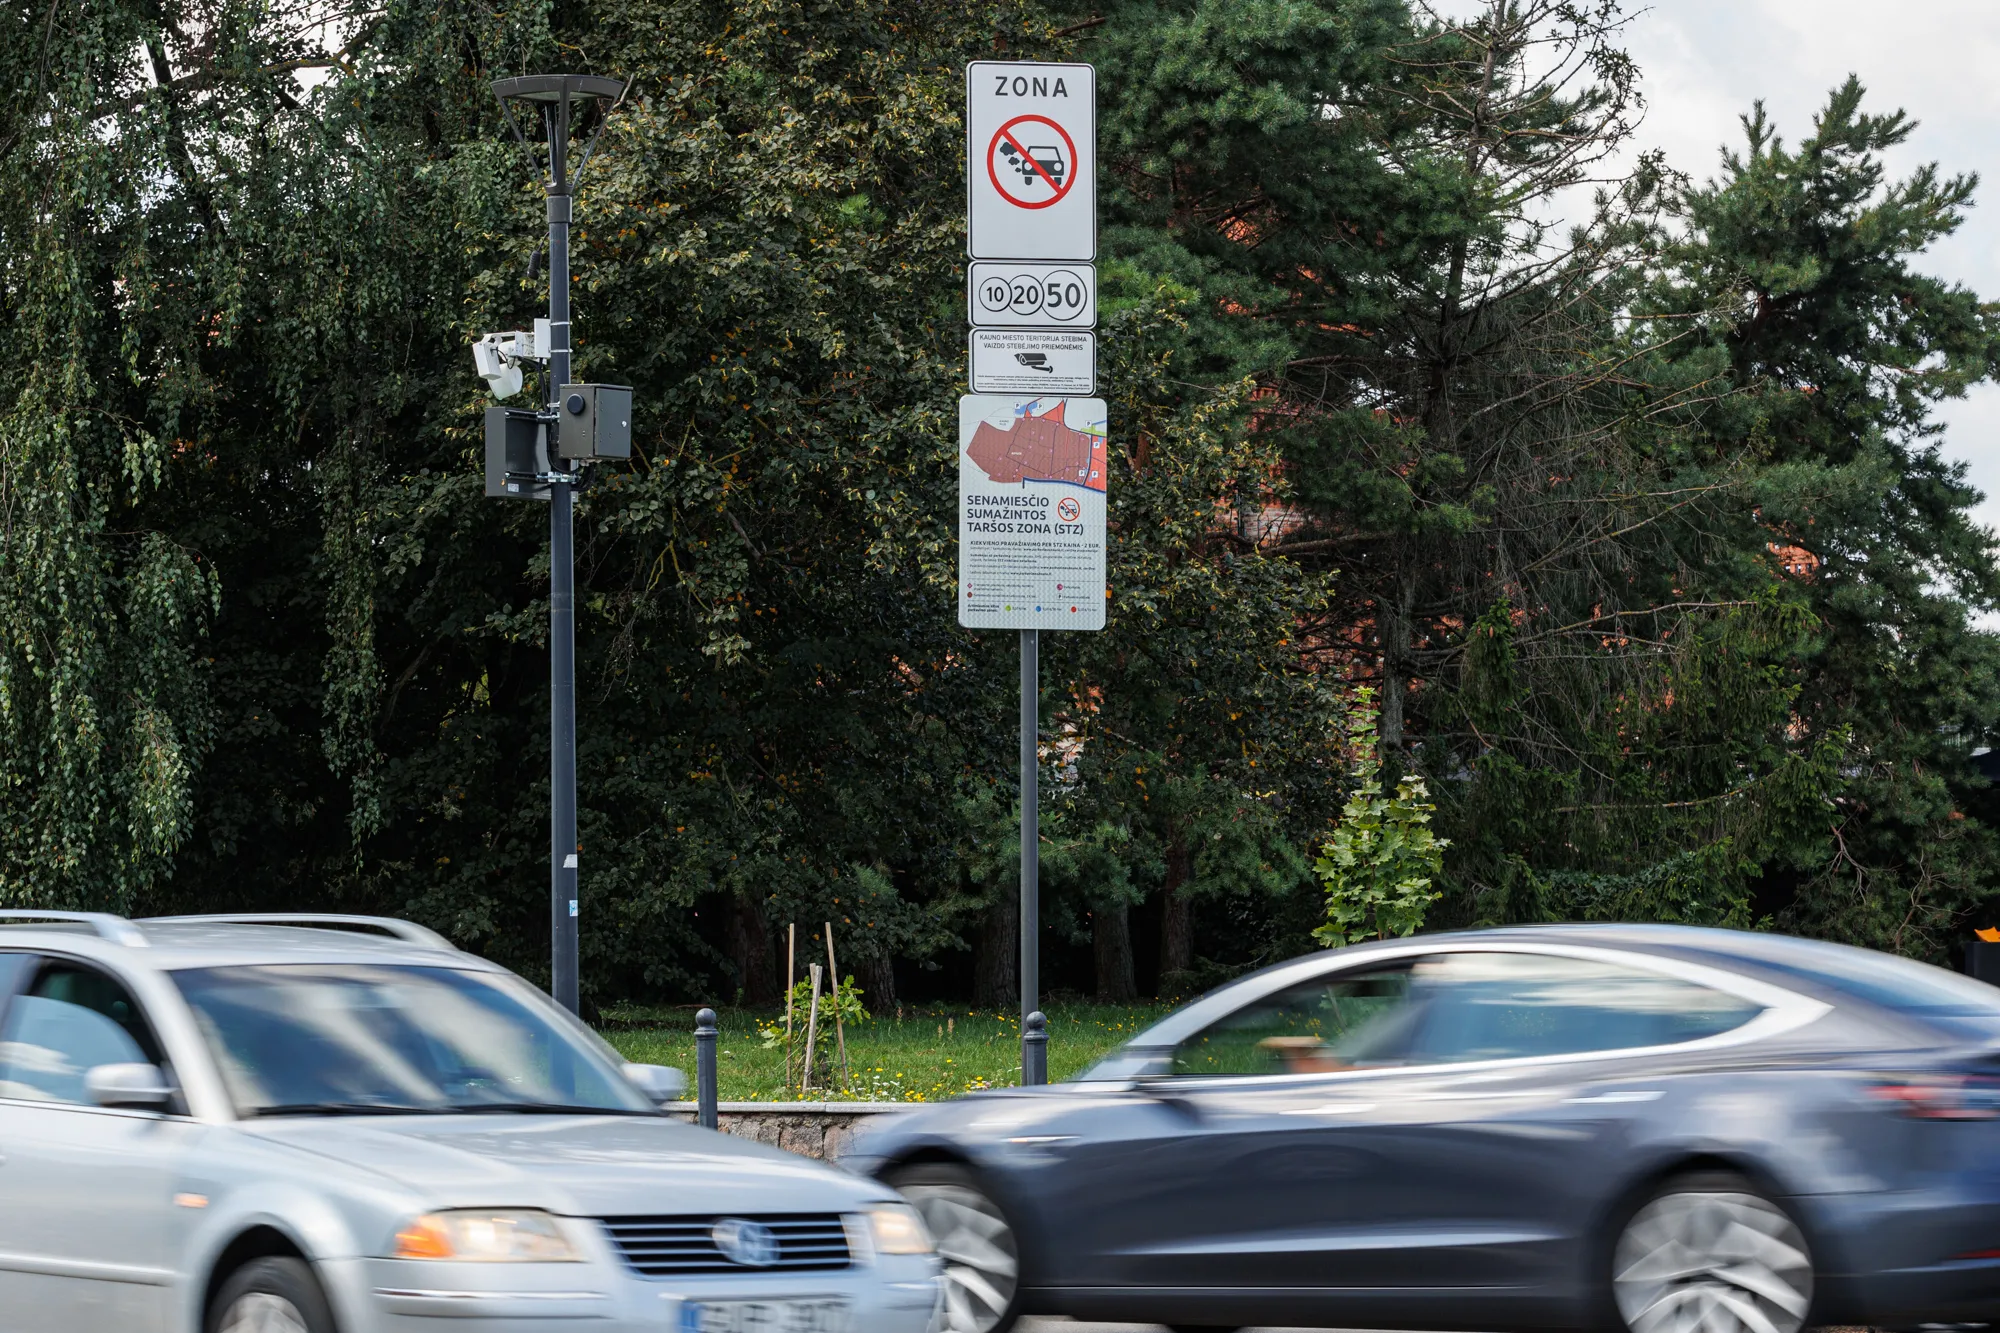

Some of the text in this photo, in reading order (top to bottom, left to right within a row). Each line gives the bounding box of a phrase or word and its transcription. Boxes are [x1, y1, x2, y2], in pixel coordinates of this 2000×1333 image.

[995, 76, 1068, 97] ZONA
[986, 283, 1081, 308] 10 20 50
[1061, 335, 1087, 343] STEBIMA
[1041, 343, 1084, 351] PRIEMONĖMIS
[967, 494, 1049, 507] SENAMIESČIO
[967, 506, 1046, 520] SUMAŽINTOS
[967, 520, 1084, 536] TARŠOS ZONA (STZ)
